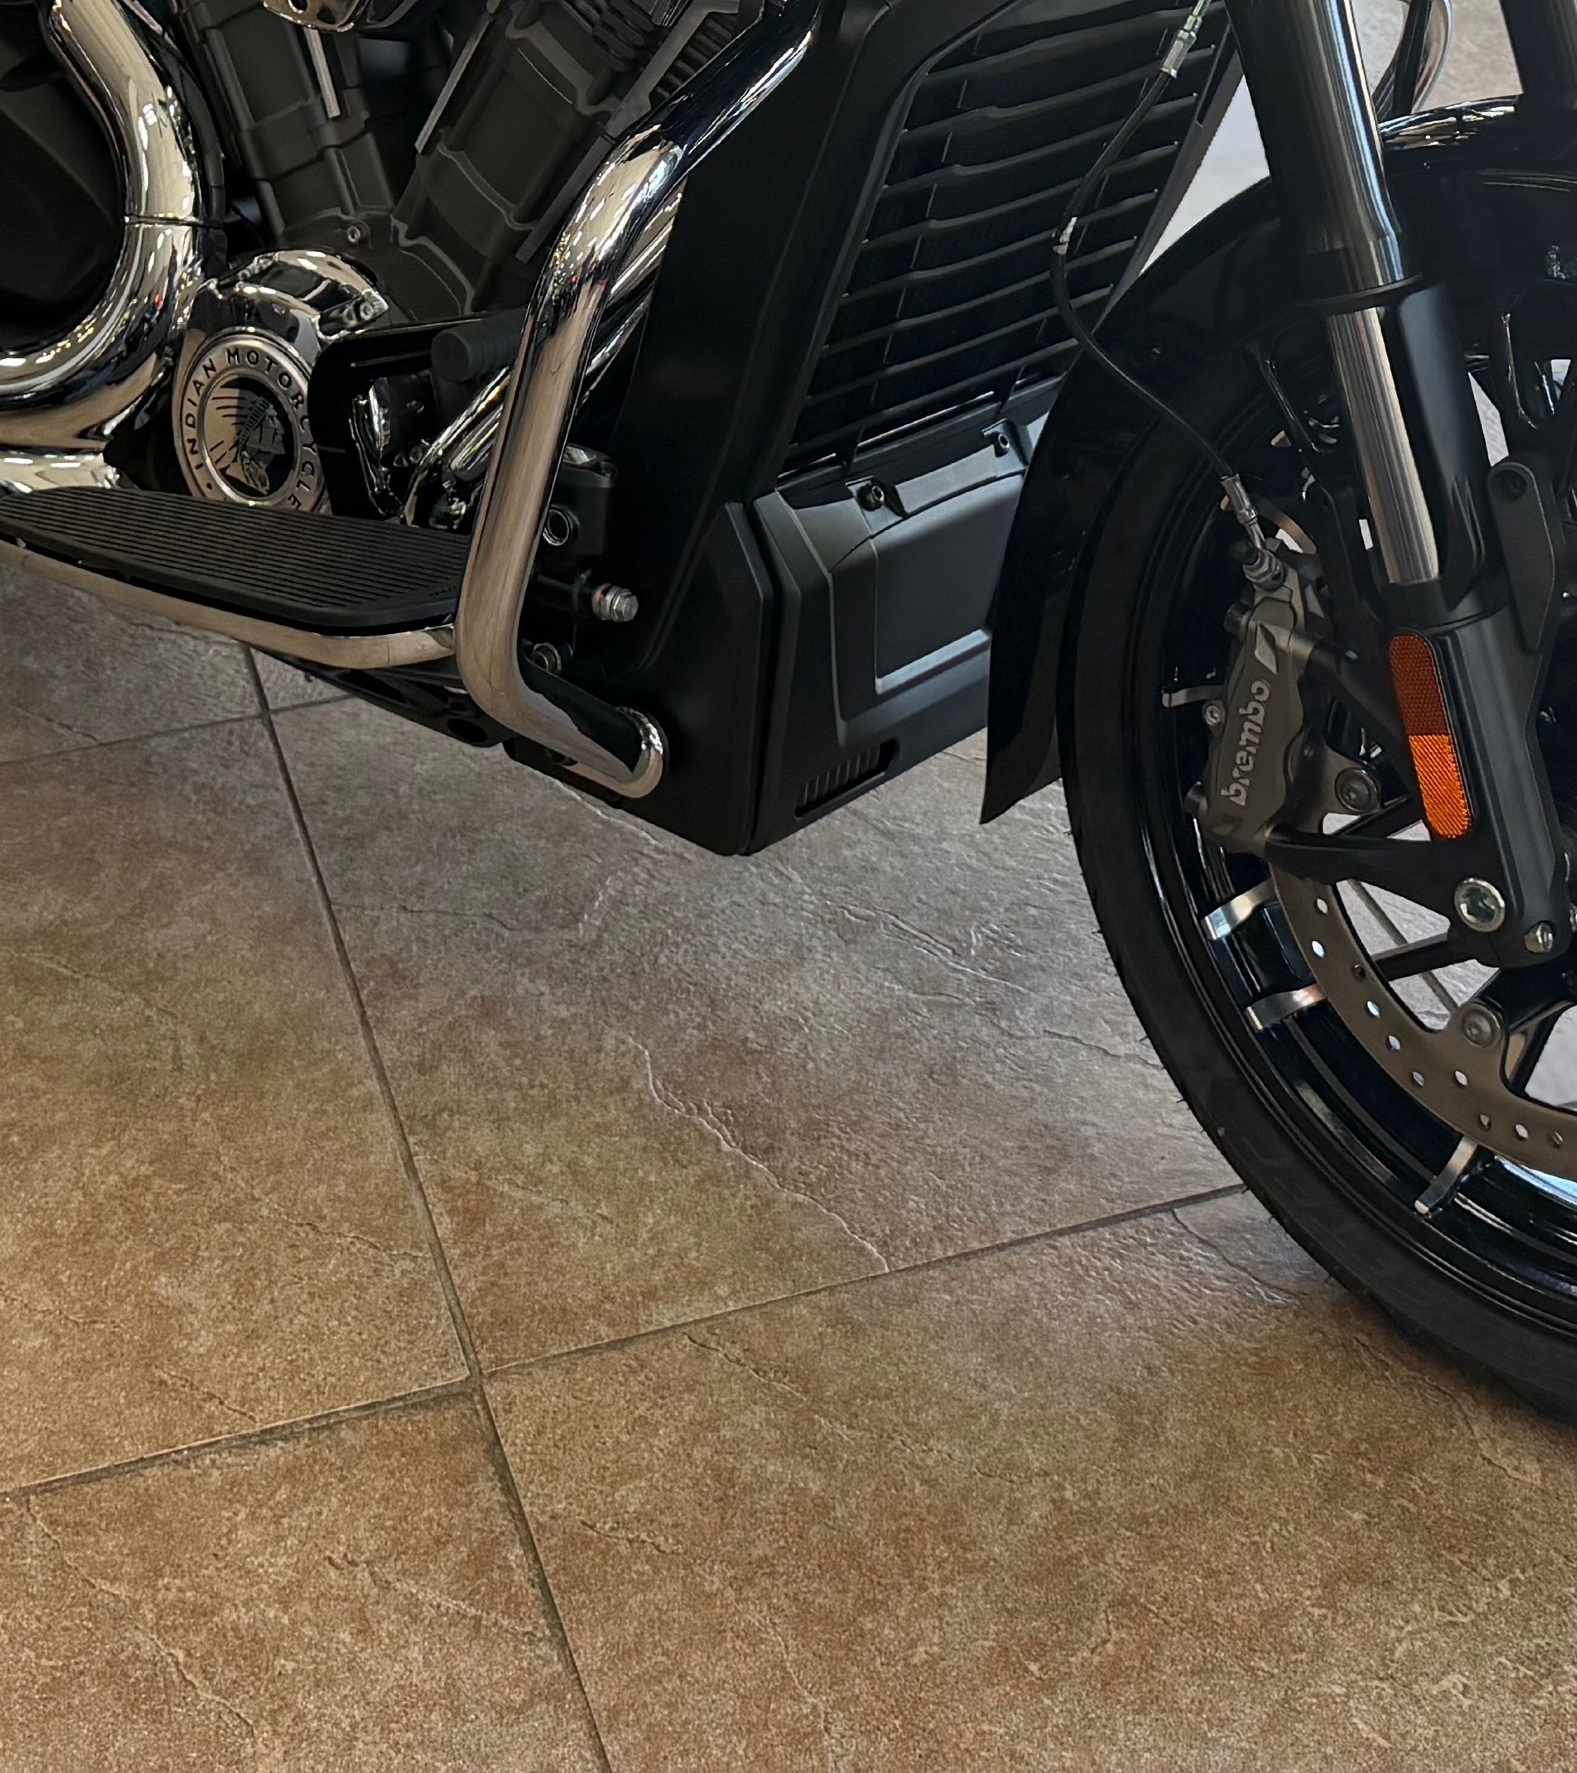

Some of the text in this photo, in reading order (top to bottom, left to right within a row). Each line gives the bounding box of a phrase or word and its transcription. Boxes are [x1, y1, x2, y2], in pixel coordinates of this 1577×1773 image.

[185, 348, 317, 511] INDIAN MOTORCYCLE
[1220, 679, 1271, 807] brembo
